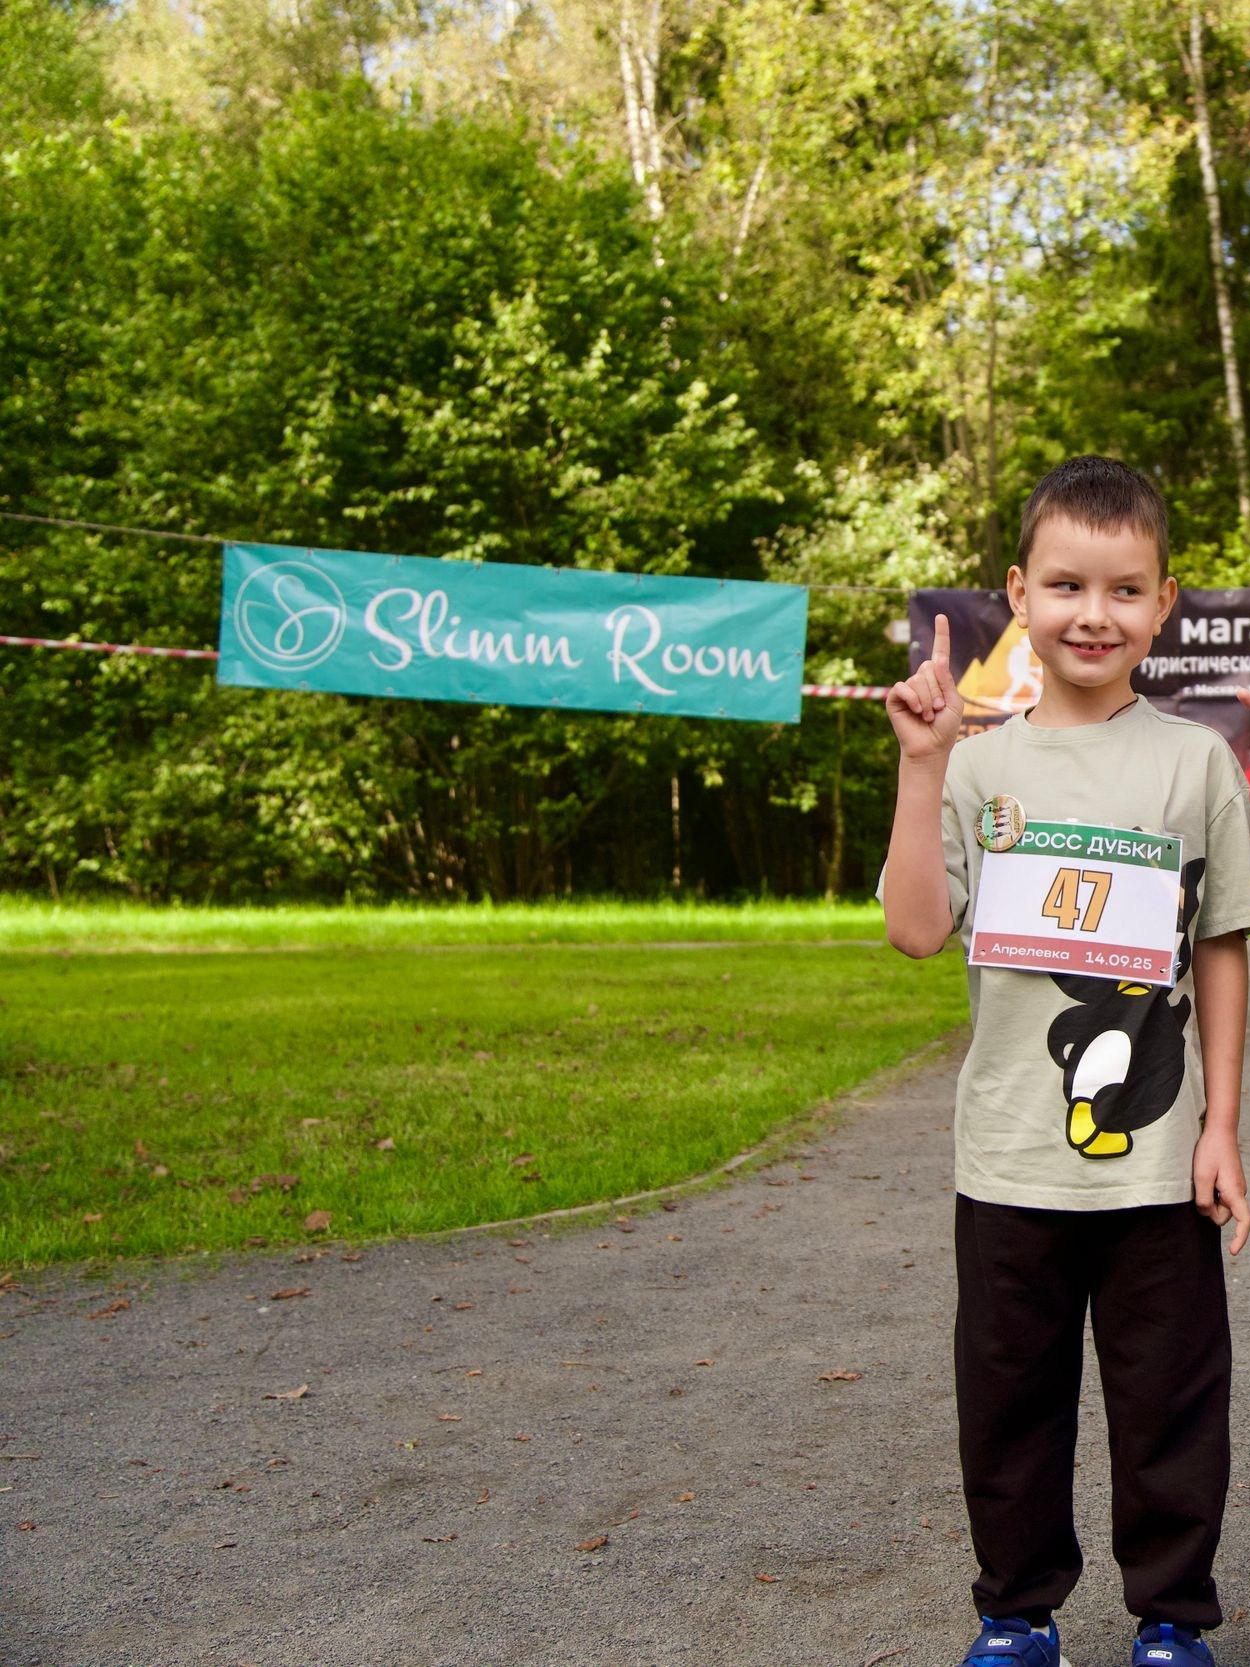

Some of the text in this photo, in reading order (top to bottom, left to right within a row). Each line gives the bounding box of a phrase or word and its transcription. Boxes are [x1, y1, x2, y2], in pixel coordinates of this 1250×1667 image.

[363, 587, 785, 696] Slimm Room
[1015, 831, 1162, 861] РОСС ДУБКИ
[1041, 867, 1113, 932] 47
[991, 943, 1153, 970] Апрелевка 14.09.25
